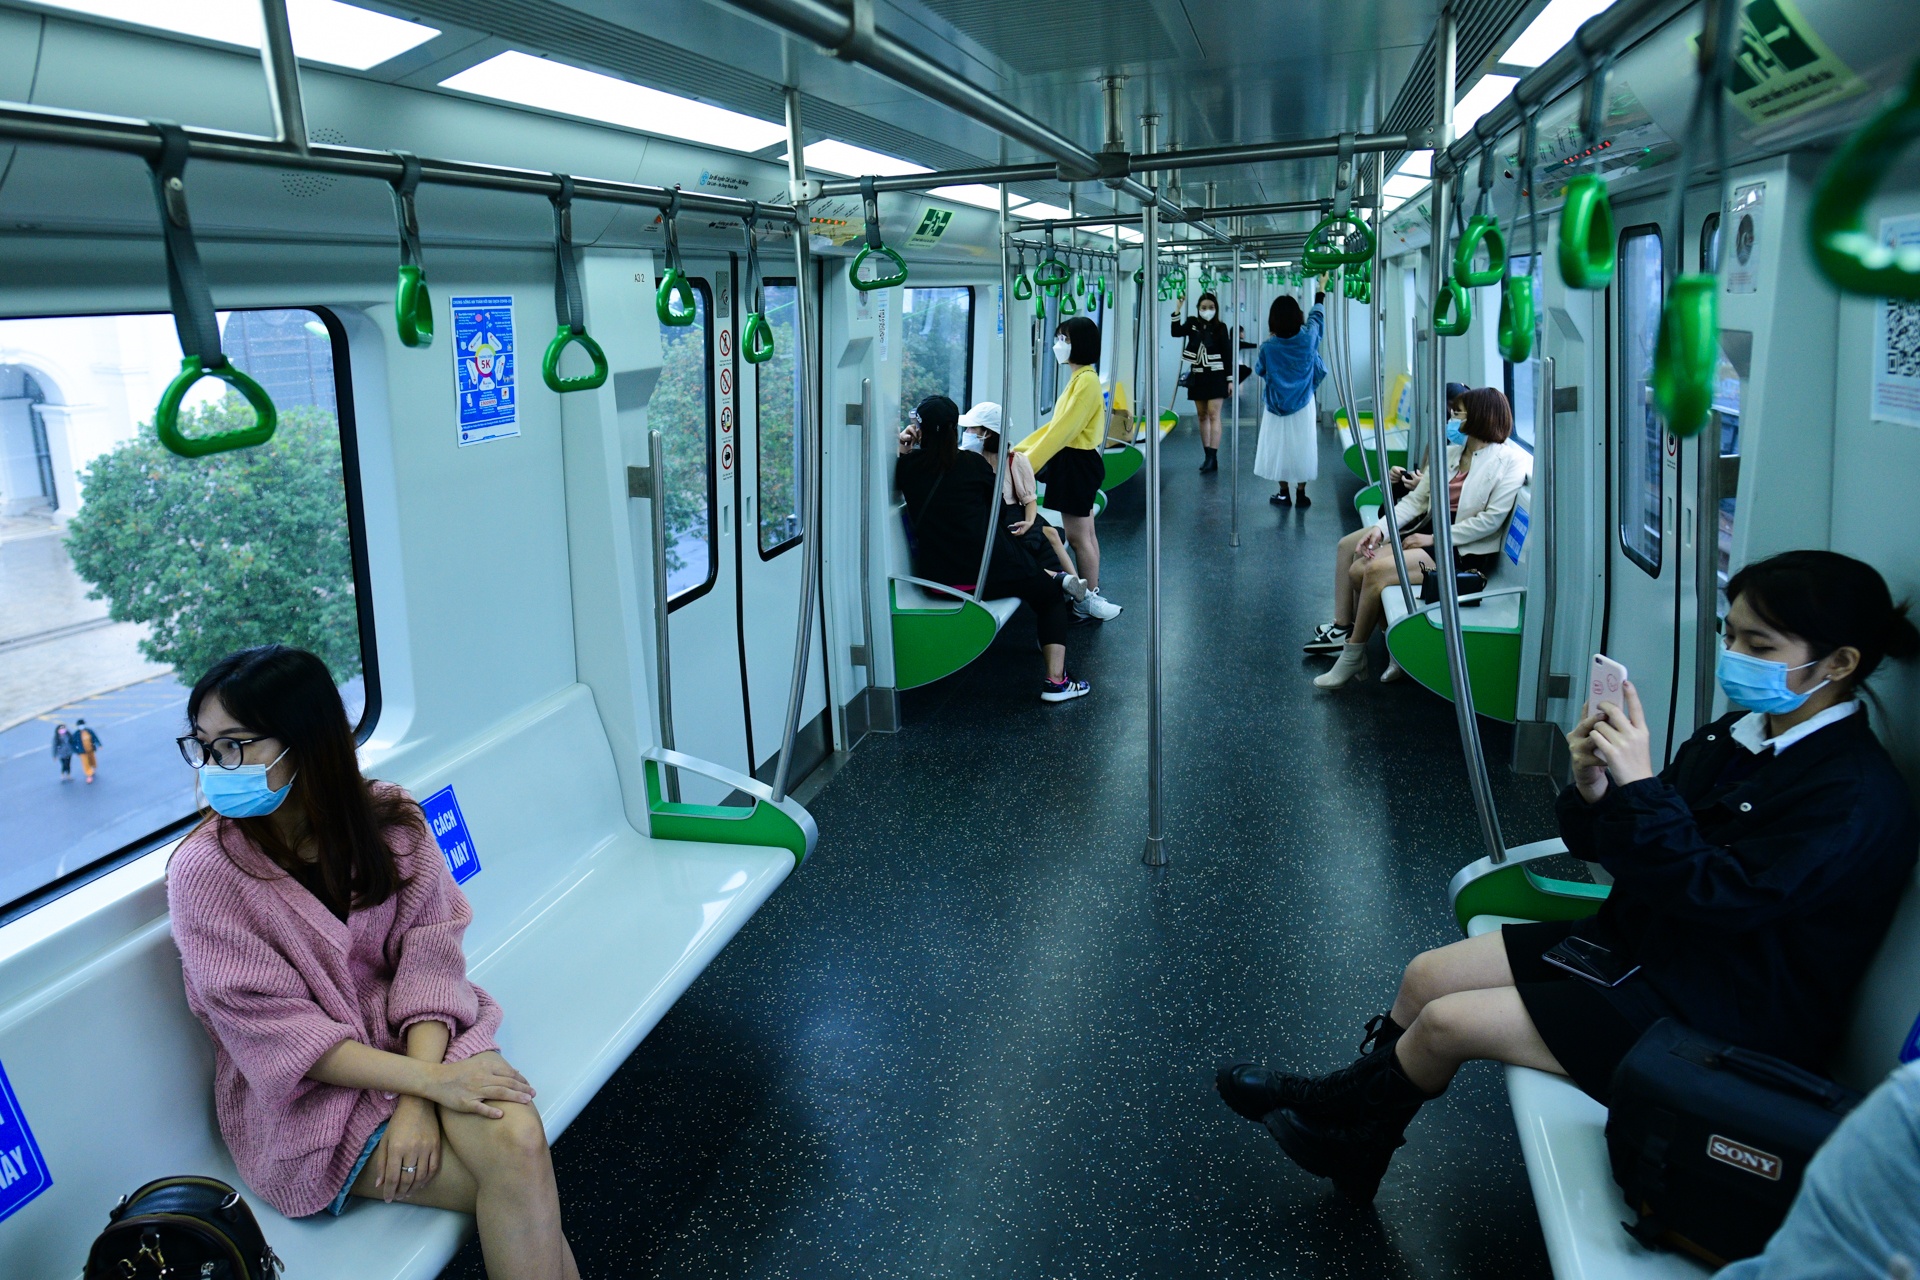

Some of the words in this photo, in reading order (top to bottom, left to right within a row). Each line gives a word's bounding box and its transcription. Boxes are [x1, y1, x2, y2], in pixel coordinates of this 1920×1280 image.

[481, 359, 491, 369] 5K
[433, 809, 457, 837] CÁCH
[450, 841, 470, 869] NÀY
[1712, 1141, 1776, 1172] SONY
